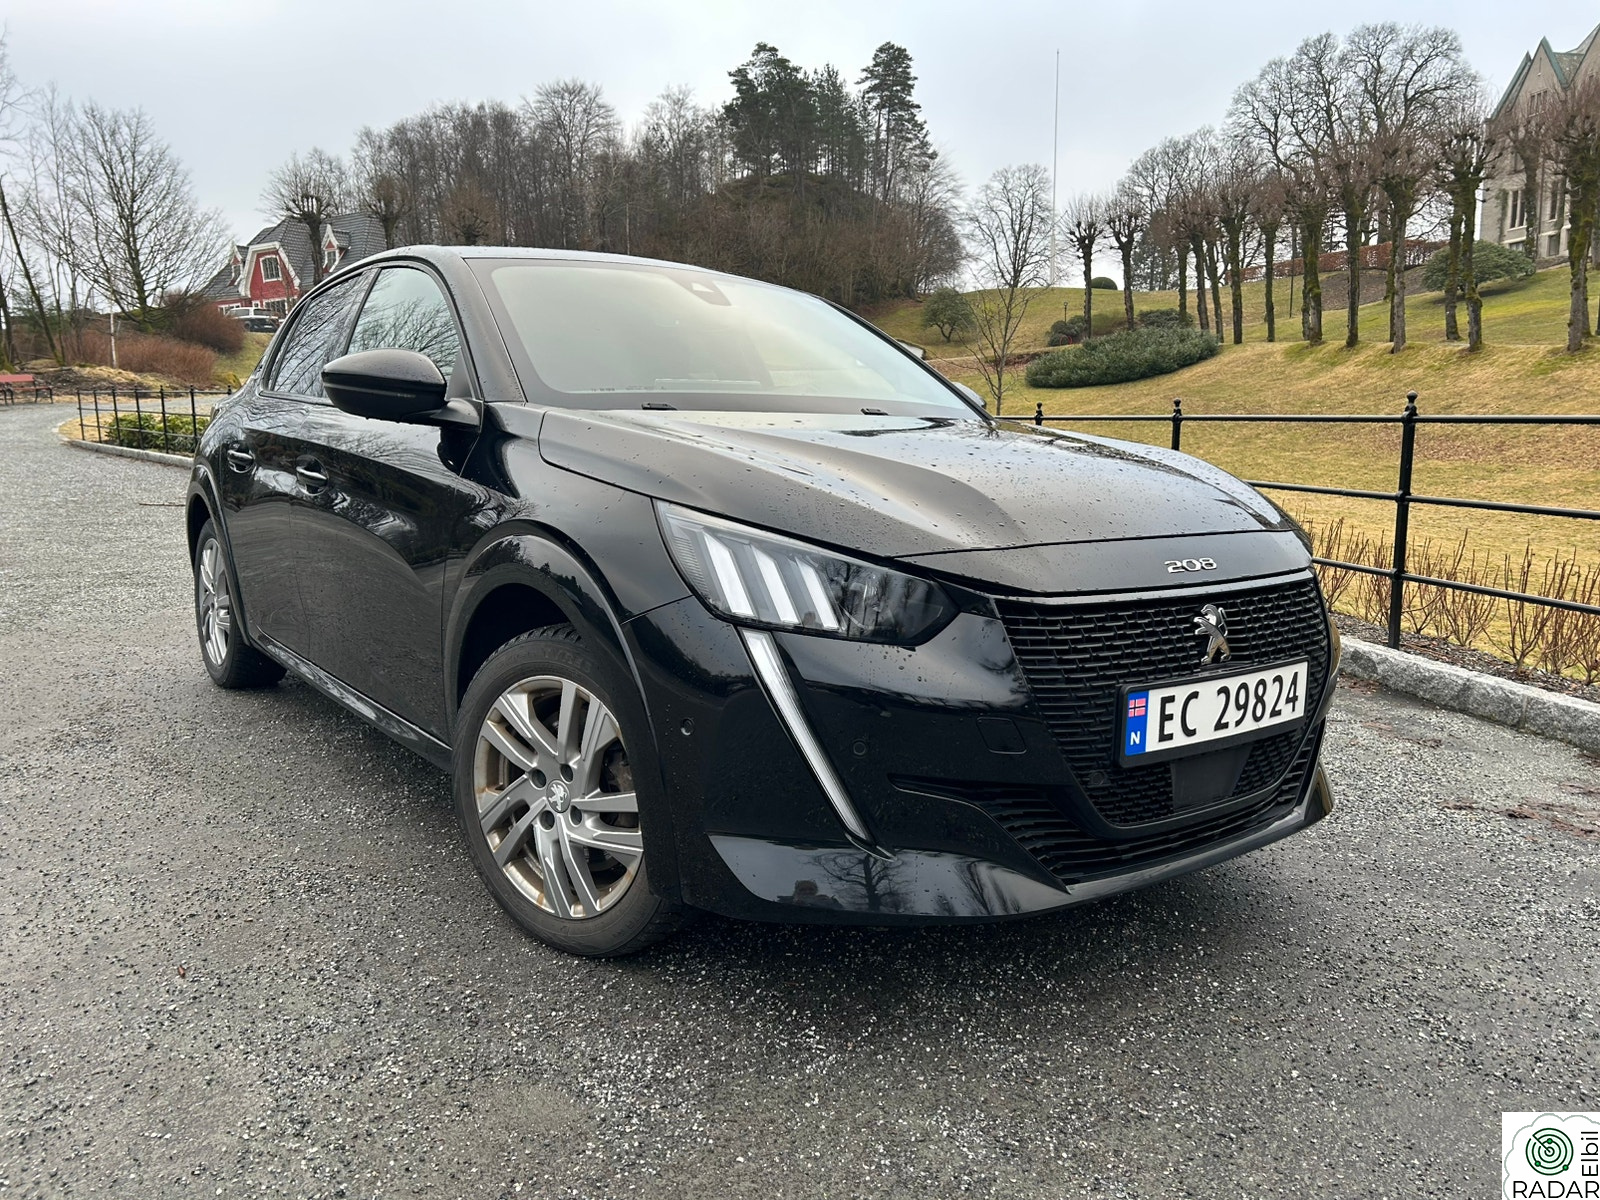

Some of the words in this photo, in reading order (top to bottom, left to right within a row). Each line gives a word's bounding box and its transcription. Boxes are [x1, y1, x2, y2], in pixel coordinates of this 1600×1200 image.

[1164, 557, 1217, 573] 208
[1158, 690, 1199, 743] EC
[1213, 671, 1299, 732] 29824
[1130, 731, 1141, 746] N
